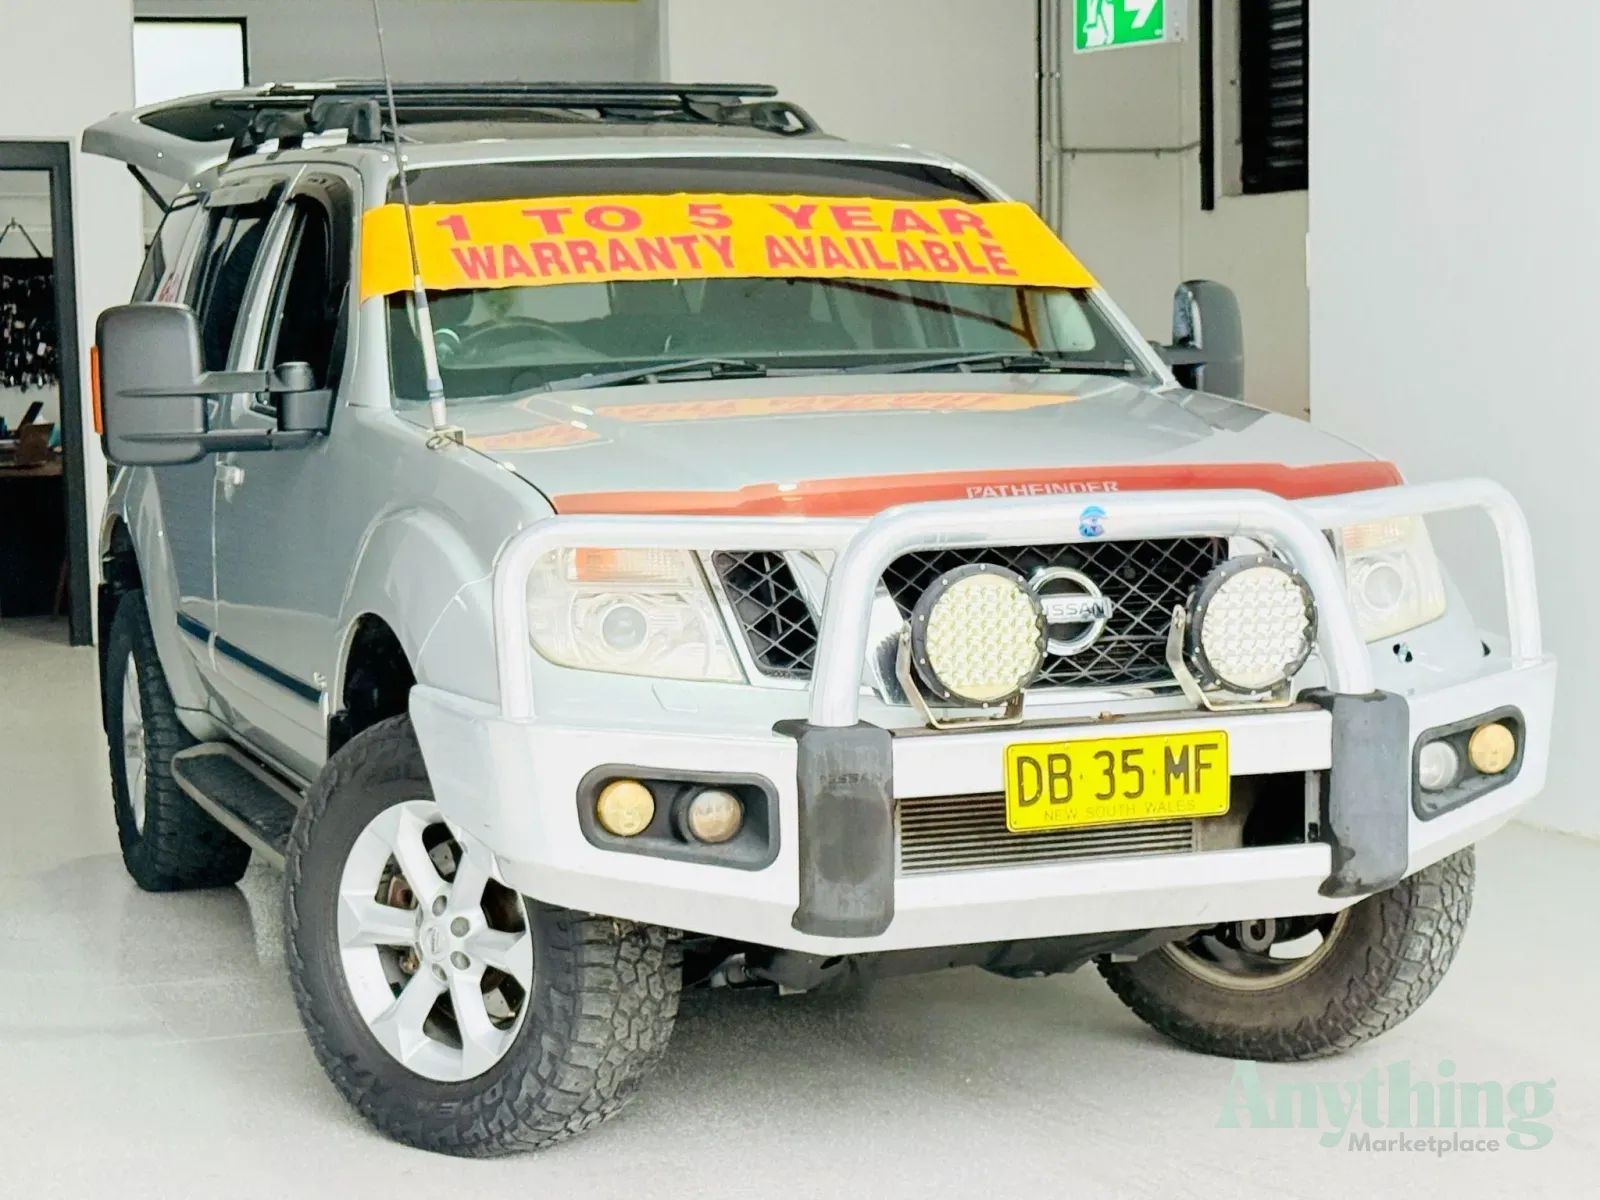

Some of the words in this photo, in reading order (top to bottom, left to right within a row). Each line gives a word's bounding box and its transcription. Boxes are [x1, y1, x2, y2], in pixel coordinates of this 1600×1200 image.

[436, 214, 471, 241] 1
[522, 205, 642, 235] TO
[688, 203, 733, 230] 5
[769, 204, 993, 239] YEAR
[451, 234, 735, 281] WARRANTY
[765, 235, 1019, 277] AVAILABLE
[965, 480, 1120, 499] PATHFINDER
[1045, 602, 1104, 617] ISSAN
[1016, 752, 1073, 808] DB
[1093, 748, 1144, 800] 35
[1164, 743, 1219, 796] MF
[1043, 808, 1077, 822] NEW
[1085, 803, 1136, 818] SOUTH
[1145, 799, 1196, 813] WALES
